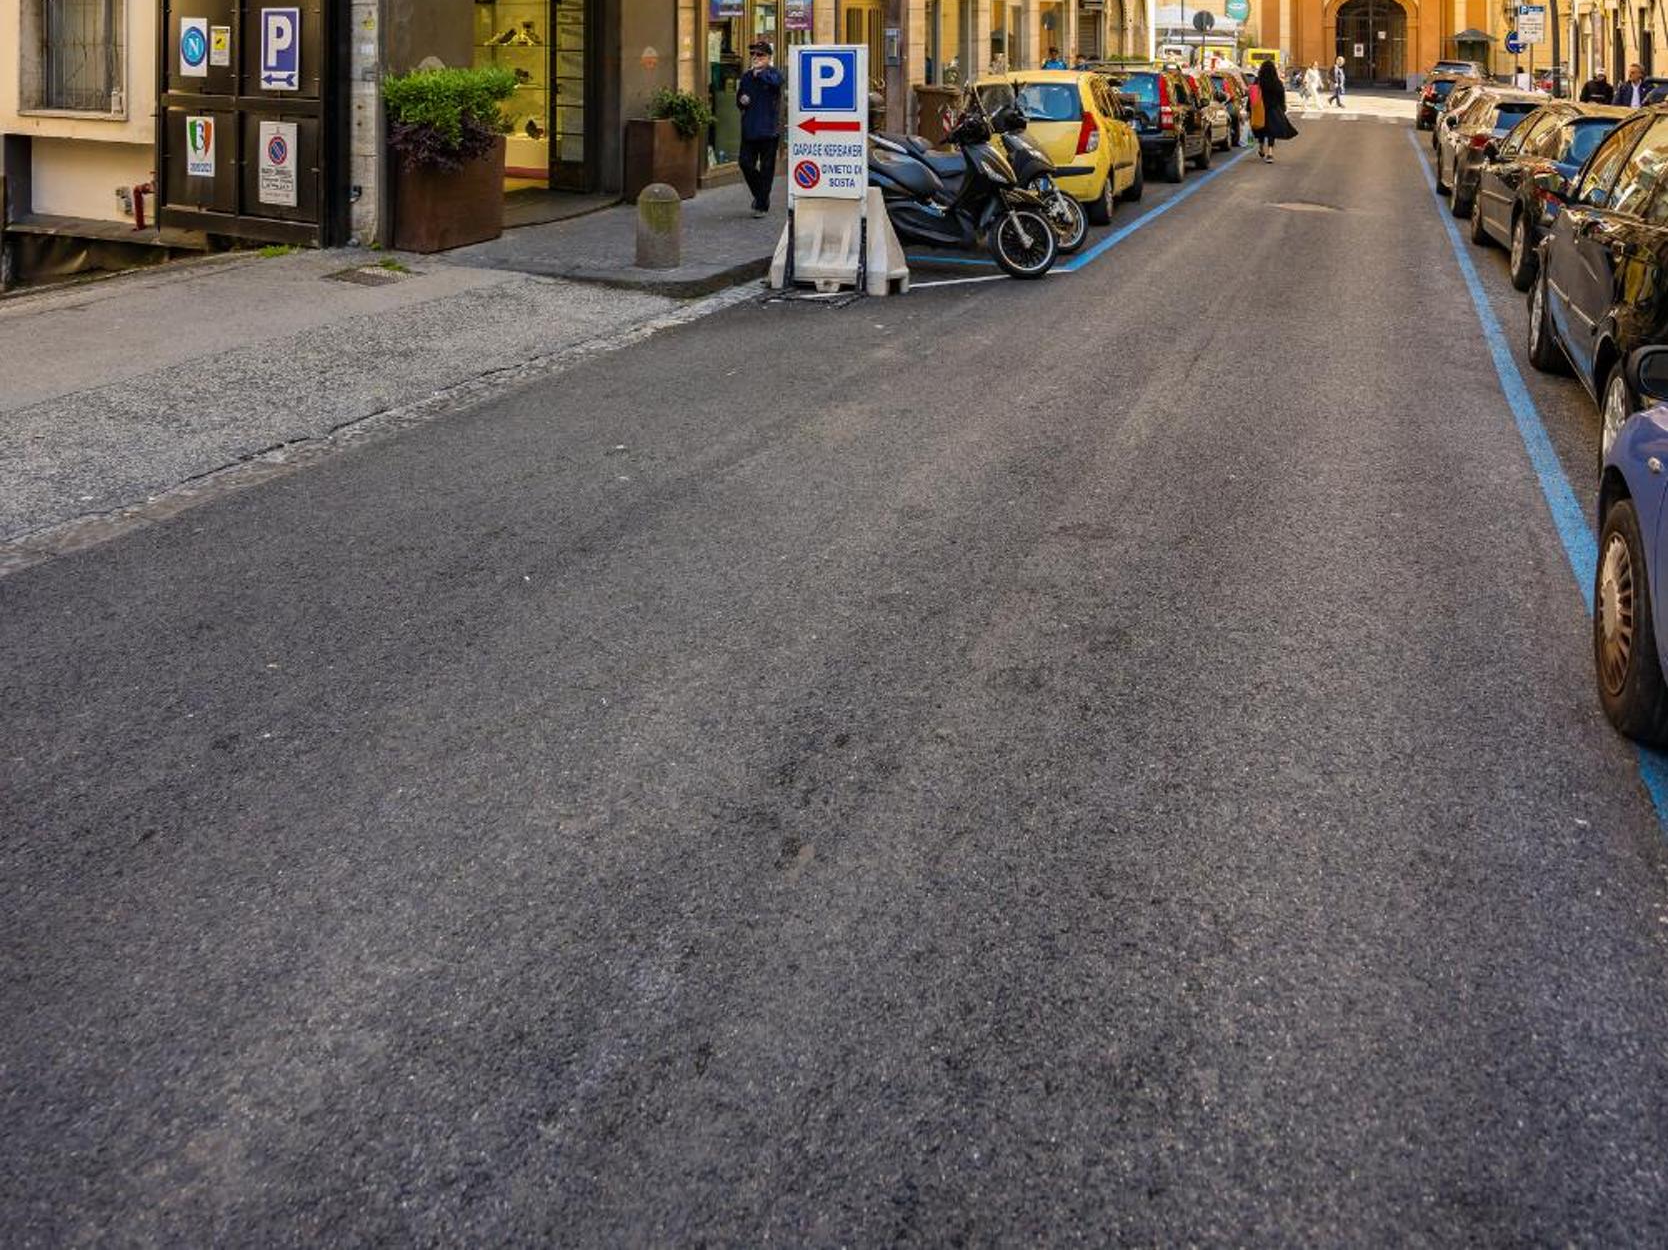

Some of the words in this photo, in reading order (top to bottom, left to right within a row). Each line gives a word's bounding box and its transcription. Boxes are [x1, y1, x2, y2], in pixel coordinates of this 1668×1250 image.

[188, 37, 200, 57] N
[267, 15, 293, 67] P
[810, 56, 845, 106] P
[792, 142, 822, 157] GARAGE
[821, 164, 852, 175] DIVIETO
[854, 165, 863, 175] DI
[828, 178, 856, 188] SOSTA
